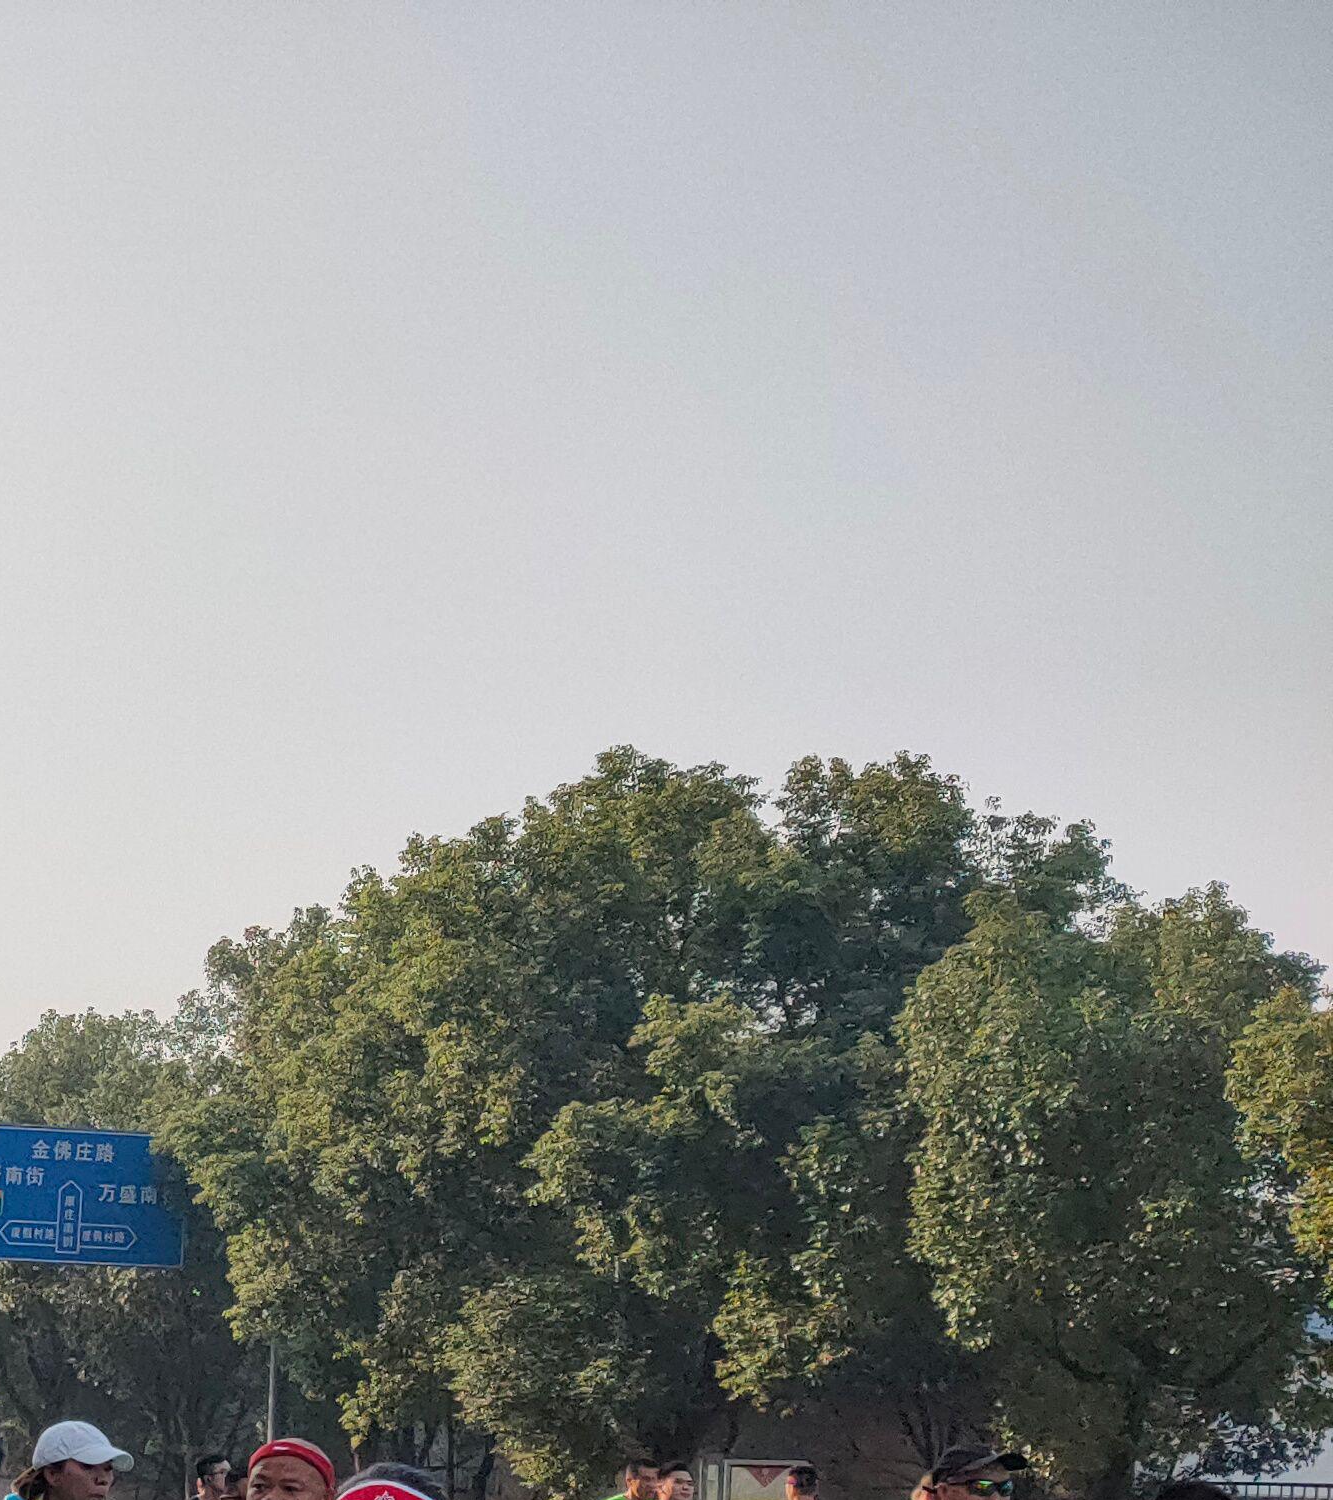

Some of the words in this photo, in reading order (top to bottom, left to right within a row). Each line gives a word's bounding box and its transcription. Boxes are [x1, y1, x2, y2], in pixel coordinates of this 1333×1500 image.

[31, 1139, 115, 1163] 金佛庄路
[98, 1184, 158, 1205] 万盛南
